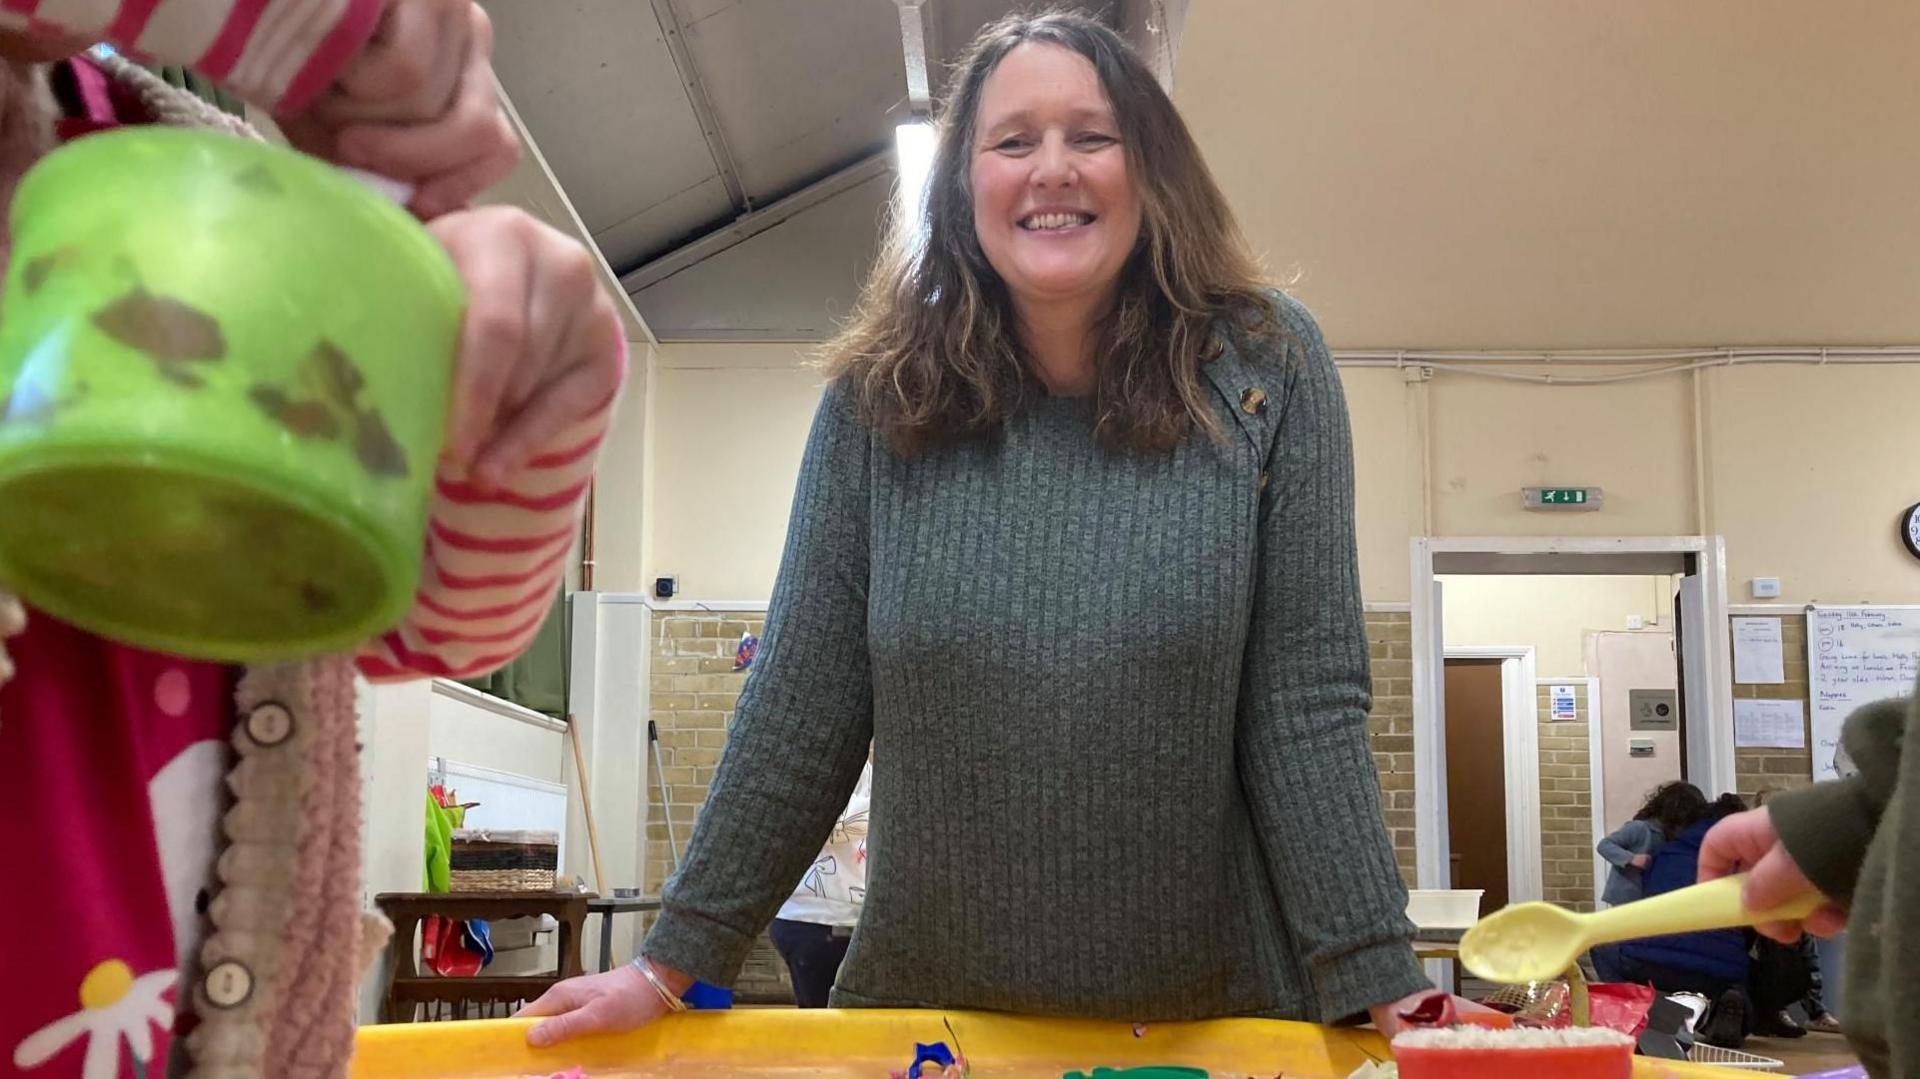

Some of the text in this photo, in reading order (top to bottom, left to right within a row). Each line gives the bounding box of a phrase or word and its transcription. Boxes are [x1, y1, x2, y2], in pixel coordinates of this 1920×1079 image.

[1911, 527, 1918, 535] 9
[1817, 611, 1842, 621] Tuesday
[1861, 609, 1886, 621] February
[1819, 653, 1838, 663] Going
[1862, 651, 1870, 662] for
[1832, 676, 1849, 686] year
